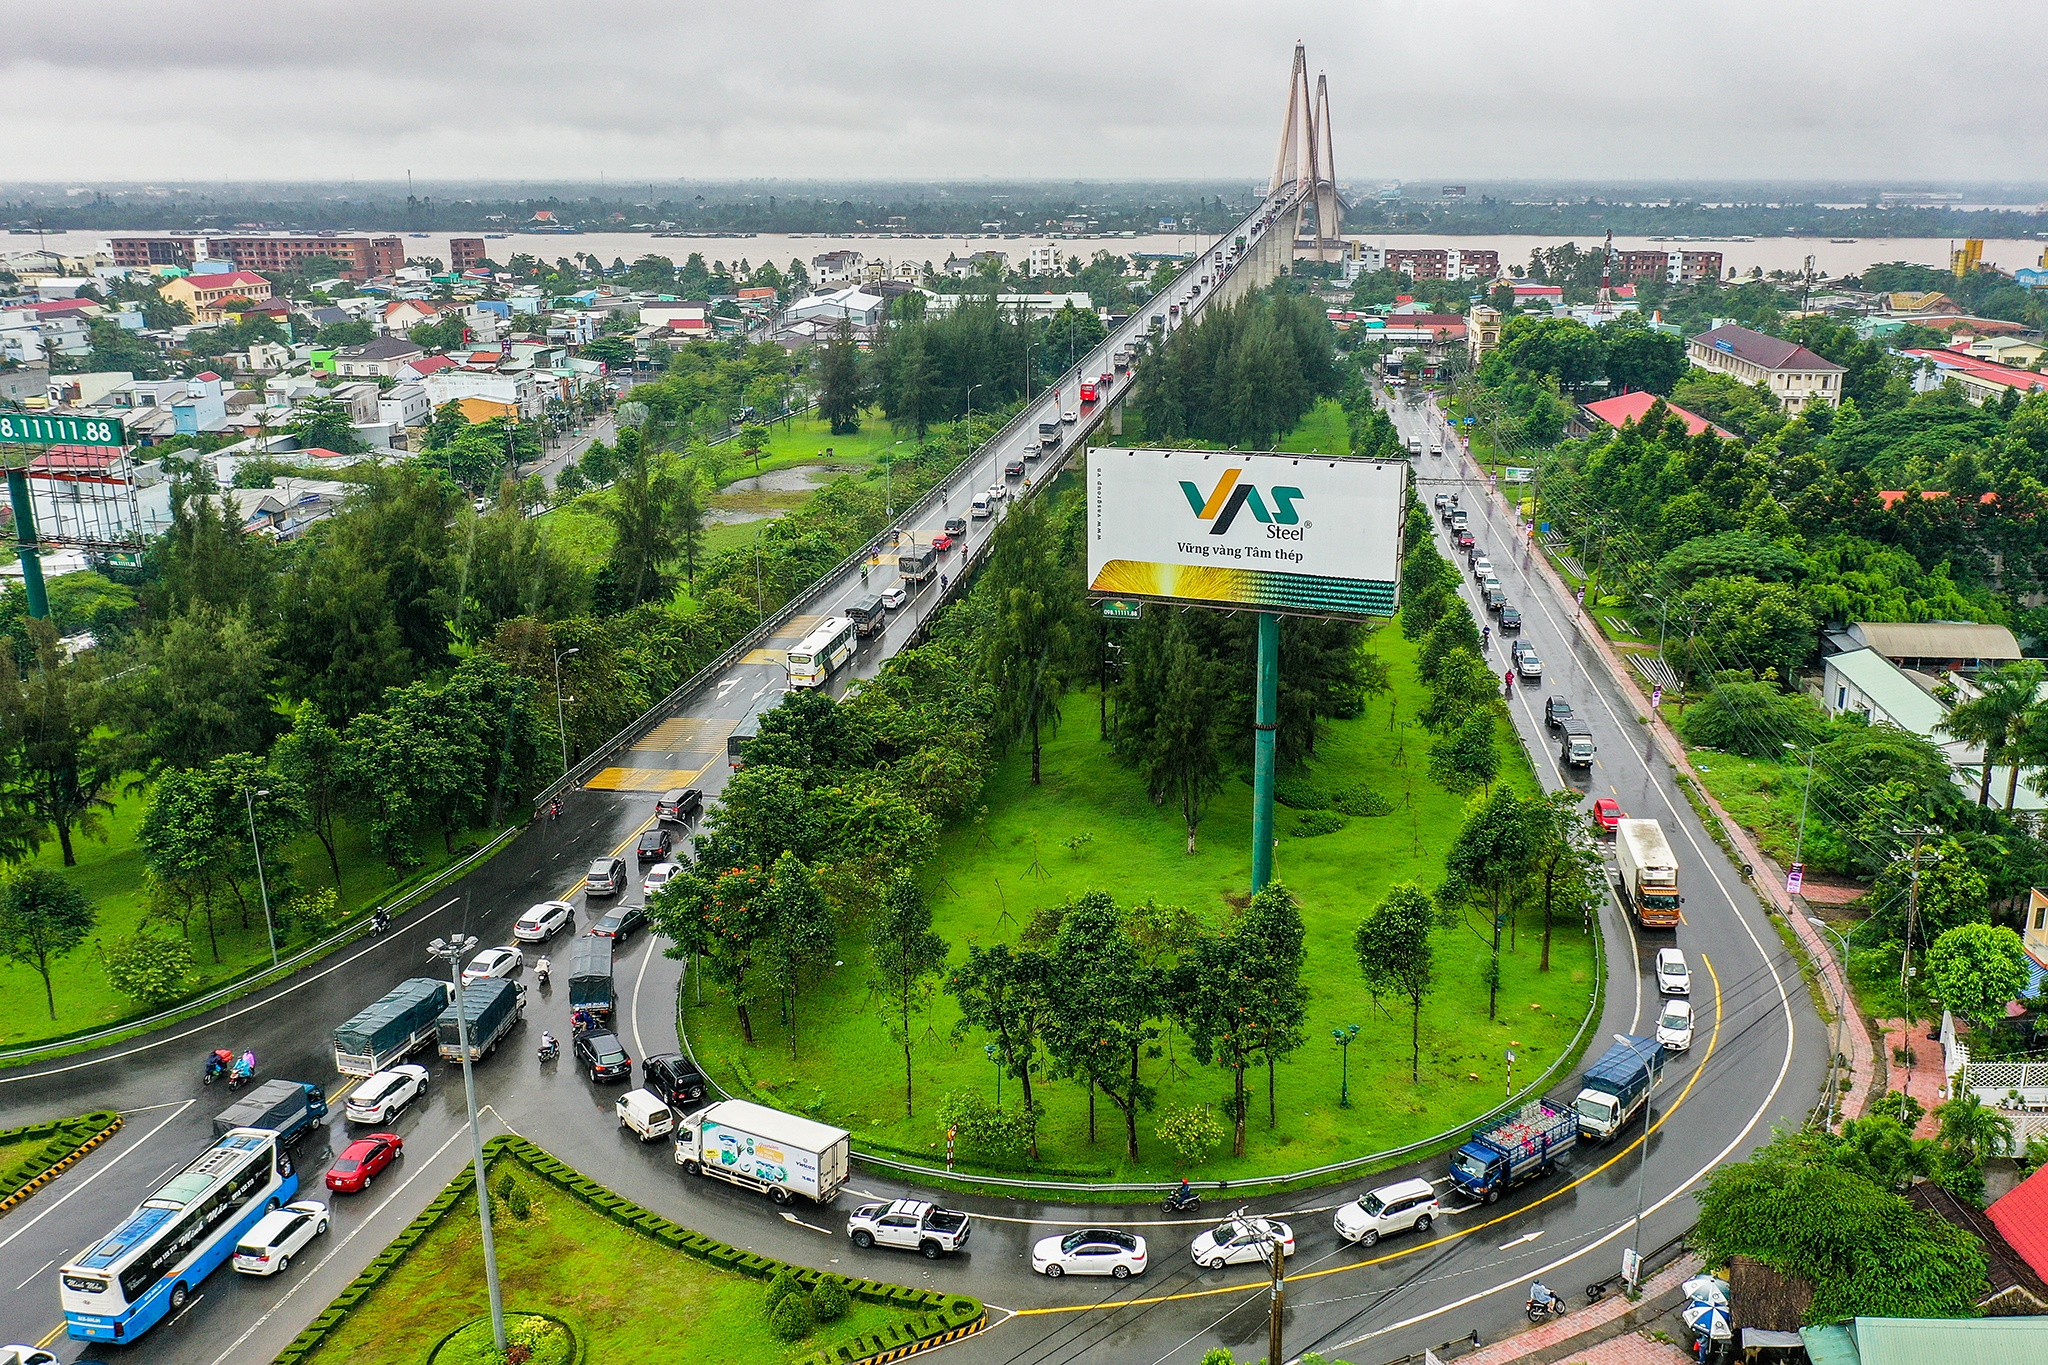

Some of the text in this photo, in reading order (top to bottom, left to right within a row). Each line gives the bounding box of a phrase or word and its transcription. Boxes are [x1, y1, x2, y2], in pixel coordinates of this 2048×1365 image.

[1, 418, 112, 442] 8.11111.88
[1179, 468, 1304, 534] VAS
[1267, 525, 1304, 541] Steel
[1177, 542, 1304, 563] Vững vàng Tâm thép
